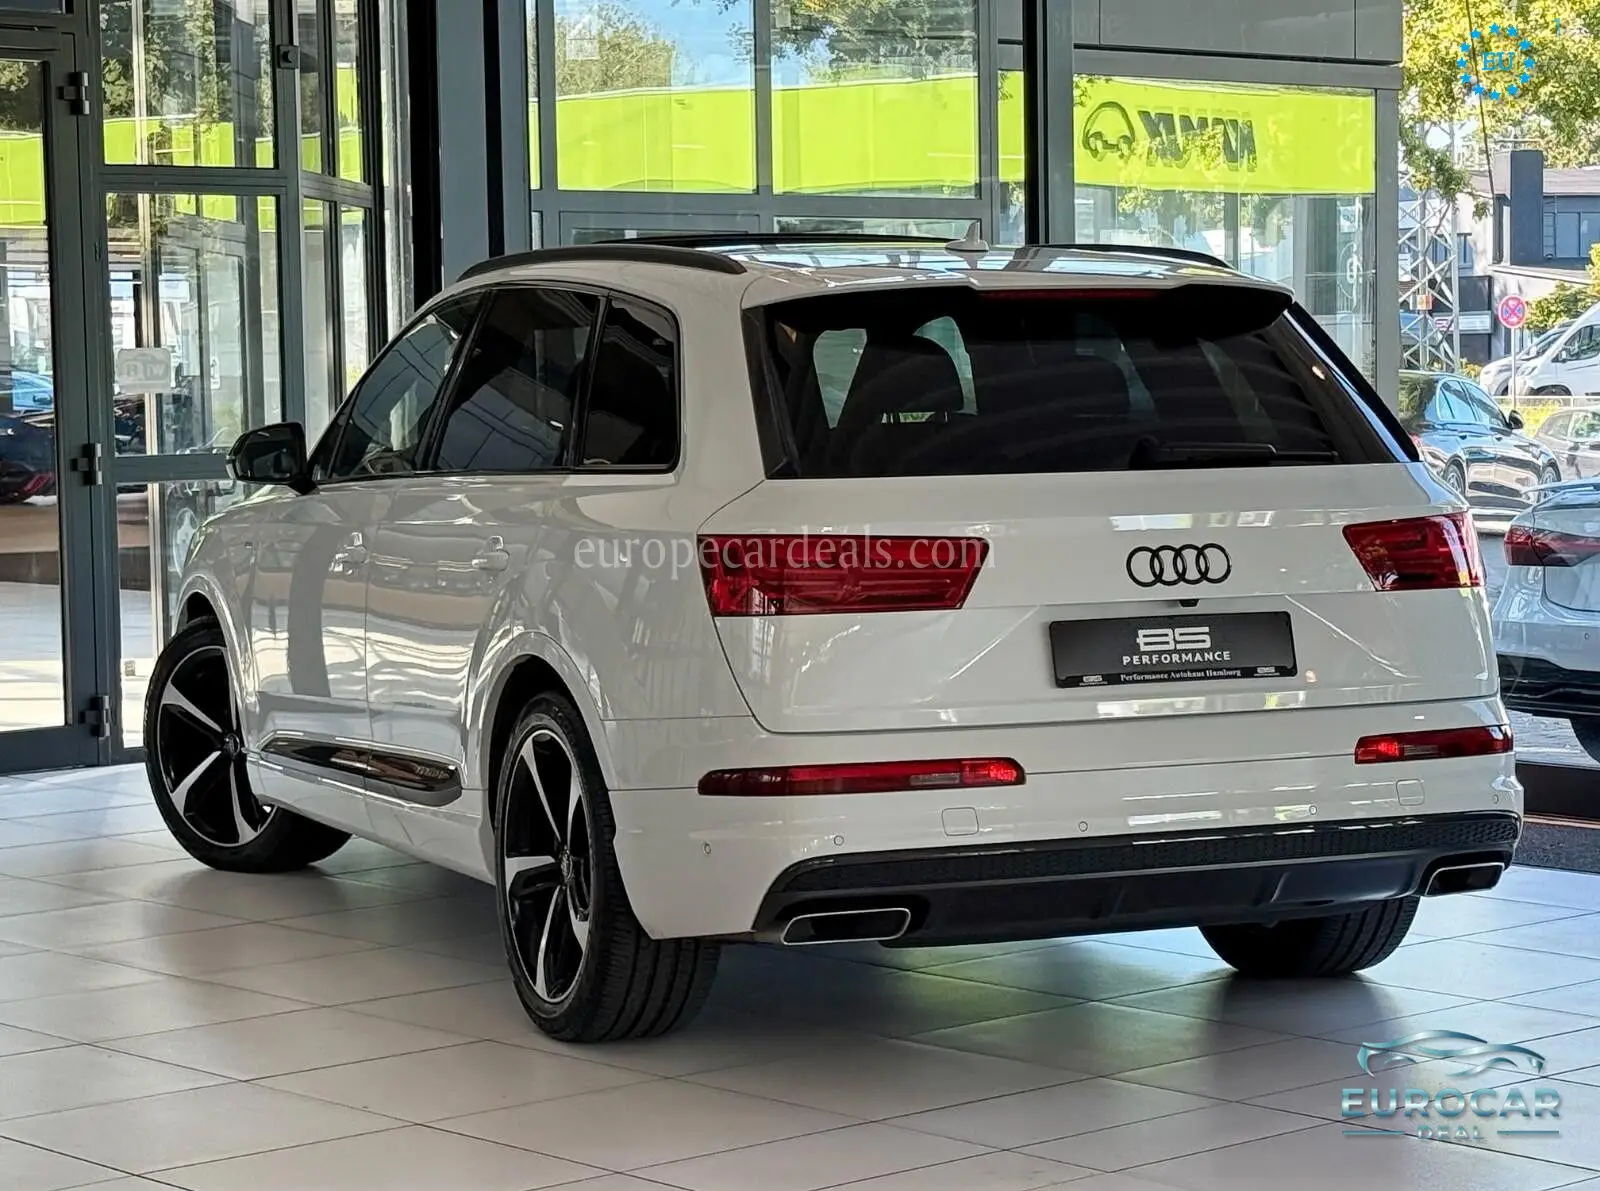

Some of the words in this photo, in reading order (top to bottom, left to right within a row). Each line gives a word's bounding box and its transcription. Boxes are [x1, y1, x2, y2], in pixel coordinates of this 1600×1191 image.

[1122, 651, 1232, 666] PERFORMANCE
[1120, 672, 1169, 682] Performance
[1170, 670, 1205, 679] Autohaus
[1206, 668, 1242, 678] Hamburg
